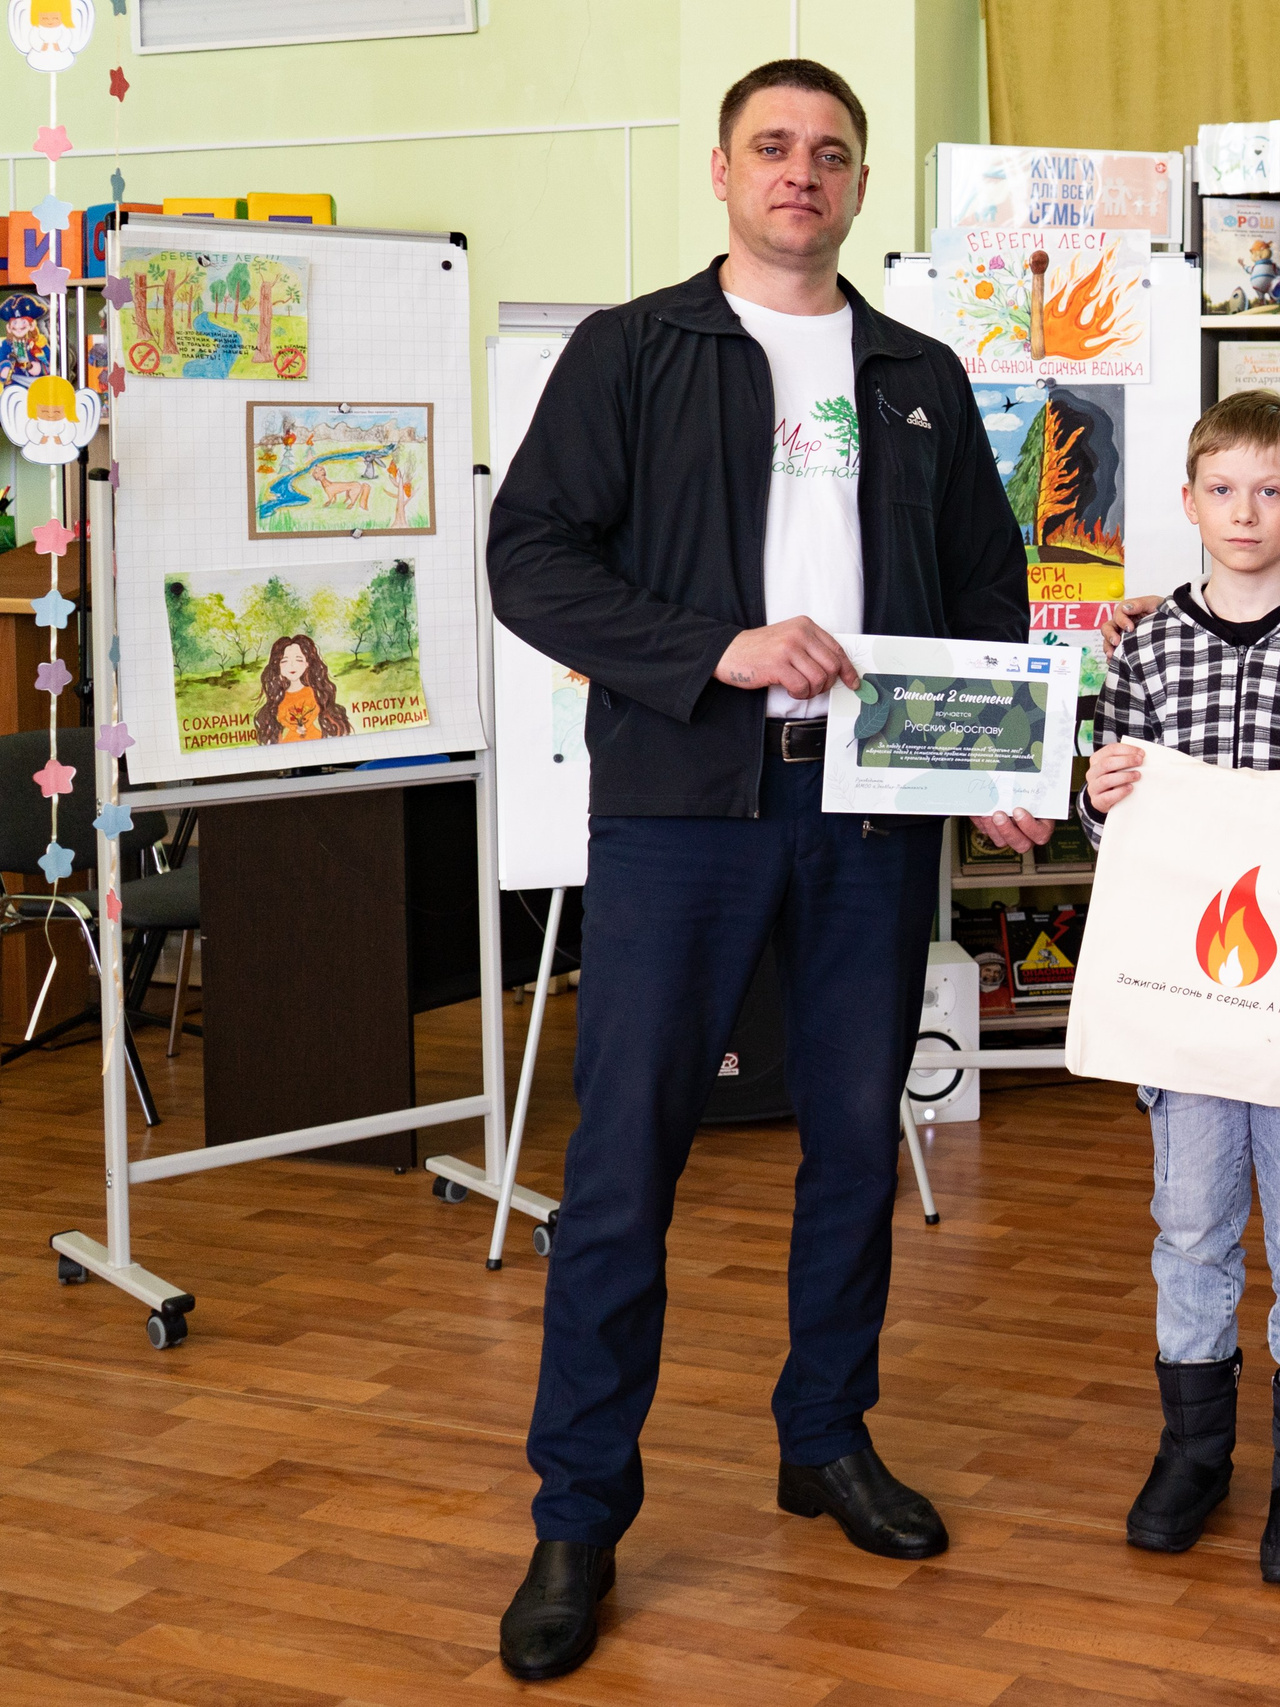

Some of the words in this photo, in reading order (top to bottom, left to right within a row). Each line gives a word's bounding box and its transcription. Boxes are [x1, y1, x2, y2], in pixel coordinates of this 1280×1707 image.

[1030, 156, 1095, 181] КНИГИ
[1030, 182, 1058, 200] ДЛЯ
[1061, 180, 1094, 200] ВСЕЙ
[1029, 202, 1095, 227] СЕМЬИ
[967, 231, 1045, 252] БЕРЕГИ
[1058, 232, 1106, 251] ЛЕС!
[1039, 360, 1086, 376] СПИЧКИ
[1092, 361, 1144, 377] ВЕЛИКА
[906, 417, 932, 430] adidas
[774, 418, 822, 468] Мир
[352, 696, 406, 714] КРАСОТУ
[409, 696, 420, 707] И
[893, 687, 945, 702] Диплом
[947, 690, 957, 703] 2
[959, 693, 1014, 705] степени
[183, 713, 250, 732] СОХРАНИ
[362, 707, 429, 729] ПРИРОДЫ!
[935, 710, 972, 718] вручается
[904, 719, 946, 733] Русских
[949, 721, 1004, 737] Ярославу
[184, 728, 257, 750] ГАРМОНИЮ
[1117, 972, 1166, 992] Зажигай
[1170, 984, 1203, 998] огонь
[1206, 991, 1213, 1000] в
[1216, 993, 1262, 1010] сердце.
[1267, 1002, 1275, 1012] А
